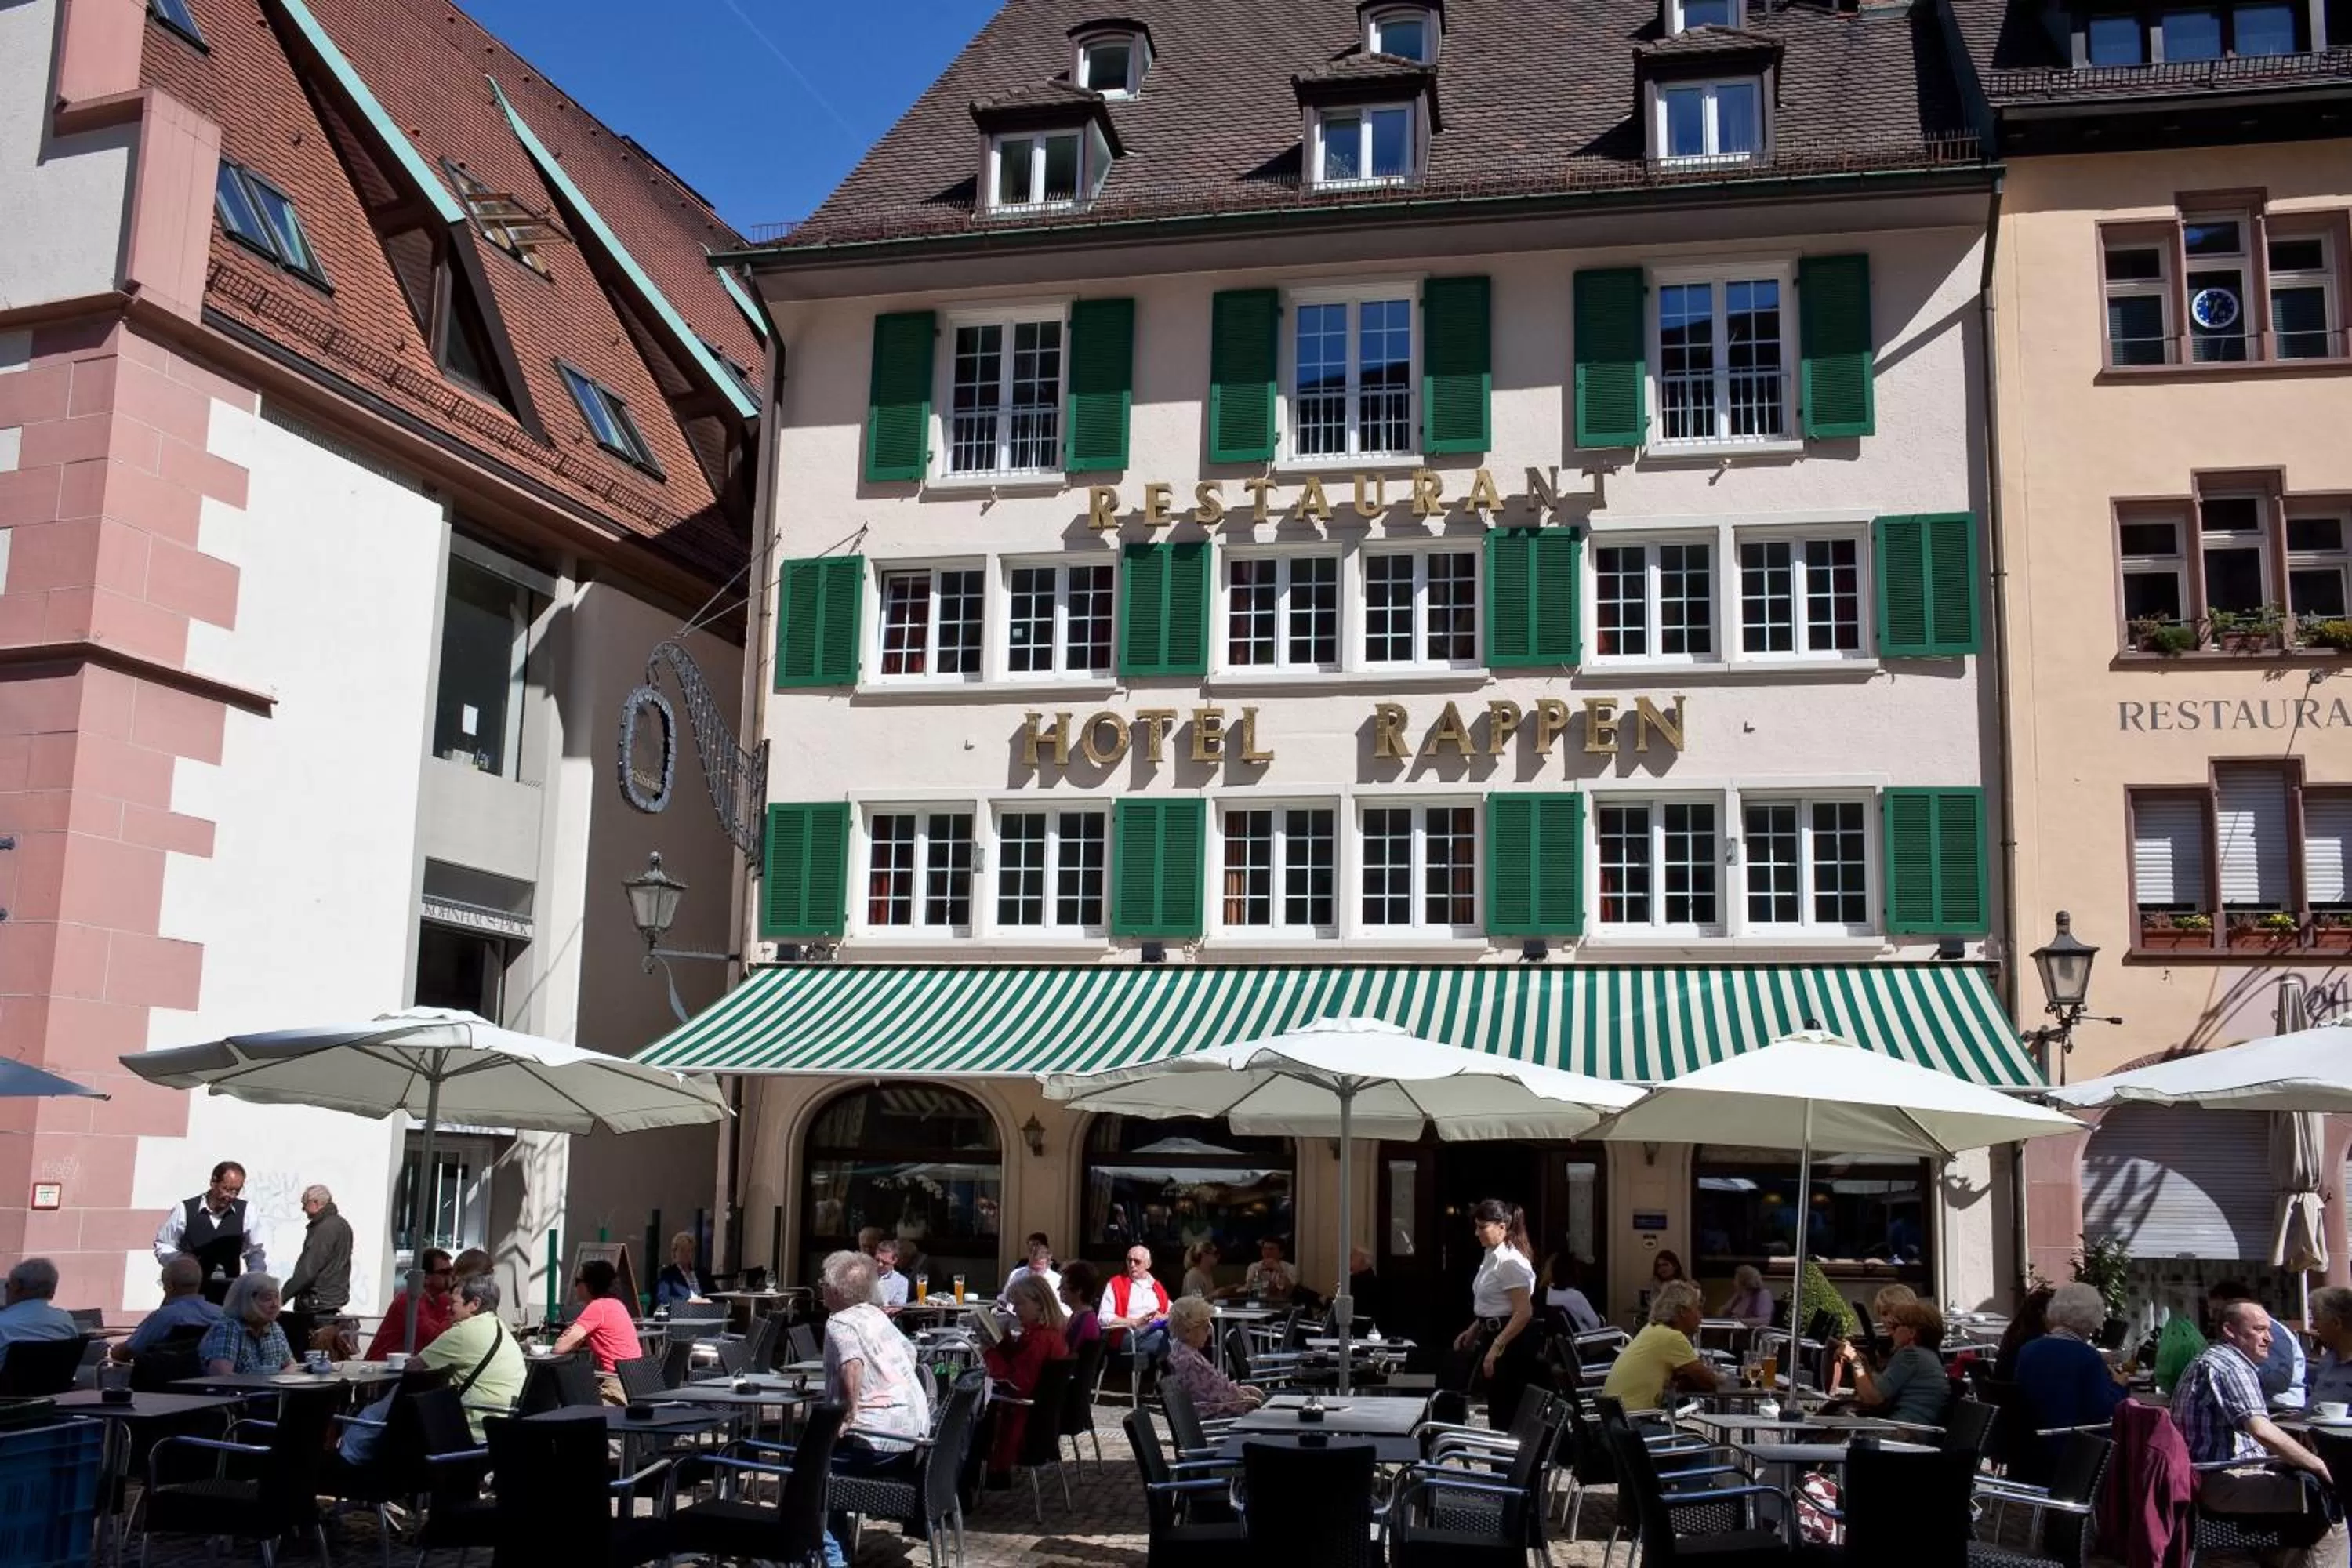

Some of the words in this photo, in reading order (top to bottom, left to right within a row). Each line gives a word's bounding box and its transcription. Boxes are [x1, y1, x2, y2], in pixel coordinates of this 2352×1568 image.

[1087, 466, 1616, 529] RESTAURANT
[1022, 707, 1275, 766] HOTEL
[1374, 695, 1686, 758] RAPPEN
[2118, 697, 2352, 733] RESTAURA
